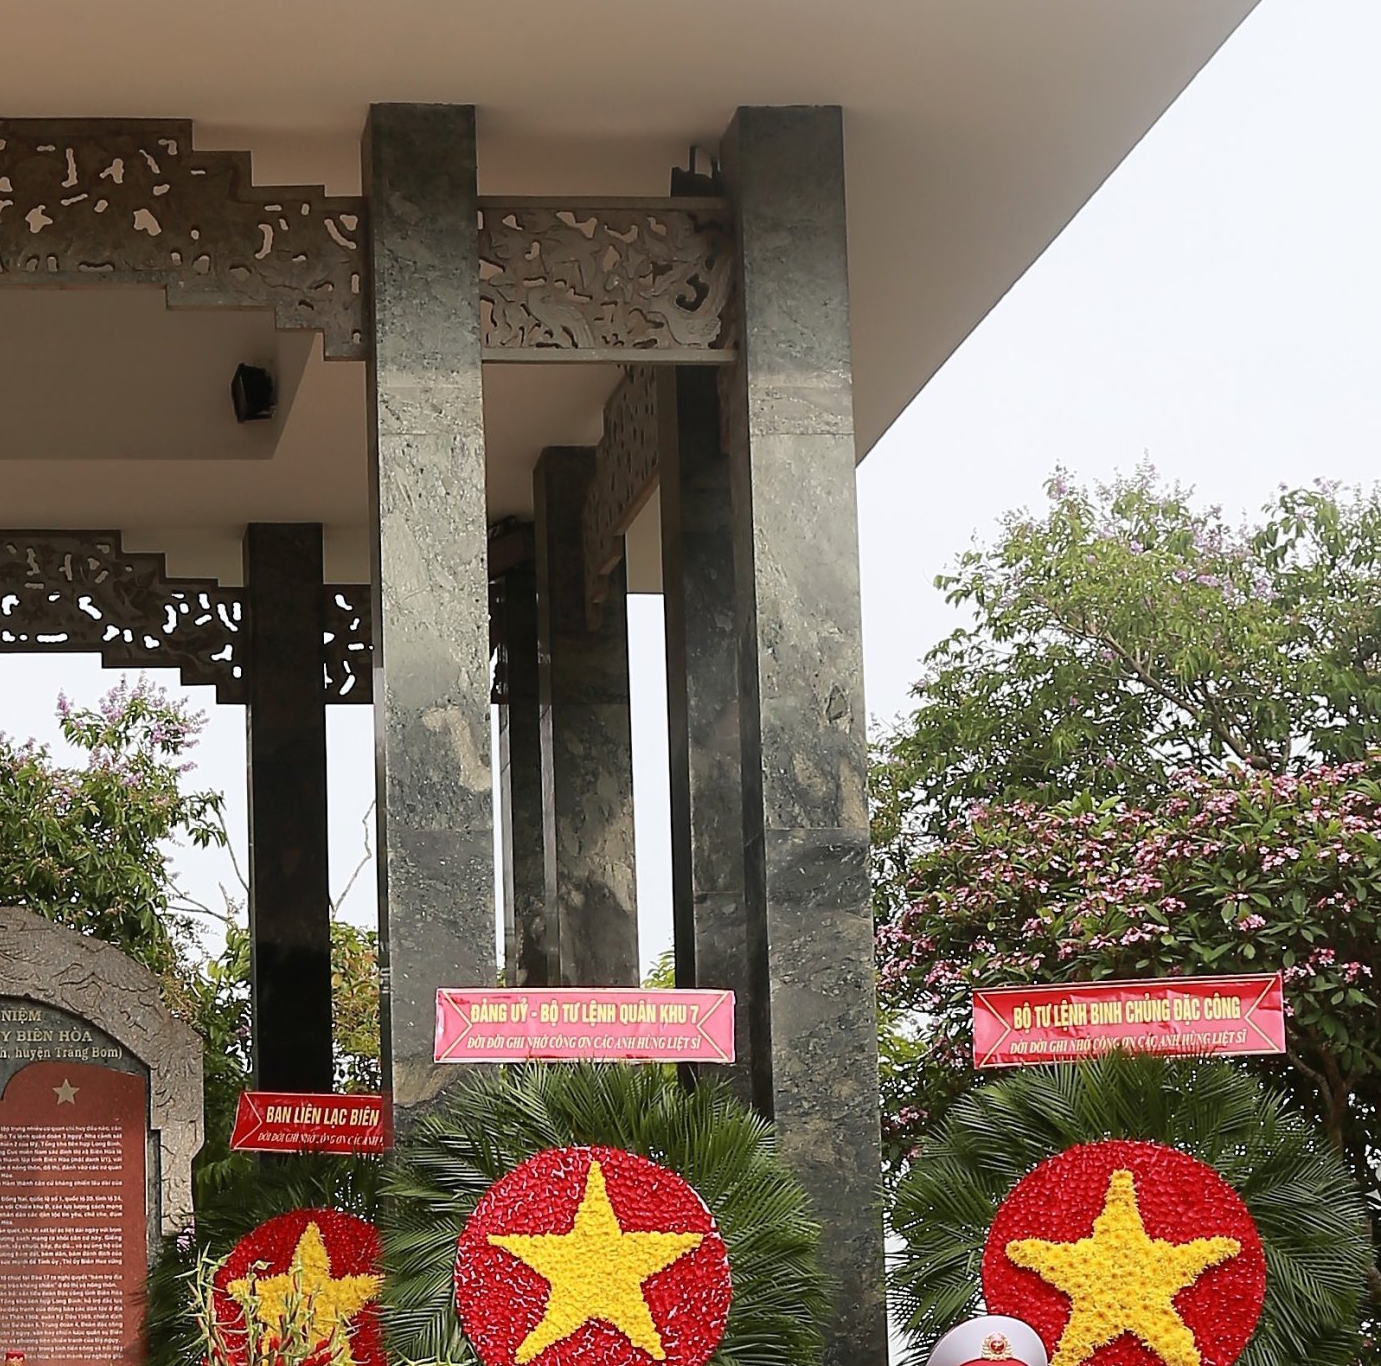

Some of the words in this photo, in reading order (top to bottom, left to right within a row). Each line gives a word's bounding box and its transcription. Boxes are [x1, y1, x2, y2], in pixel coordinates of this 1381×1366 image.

[1, 1008, 42, 1024] NIỆM
[470, 999, 507, 1024] ĐẢNG
[510, 998, 528, 1023] UỶ
[540, 1004, 558, 1027] BỘ
[562, 1003, 581, 1023] TƯ
[582, 1001, 616, 1027] LỆNH
[620, 1000, 656, 1025] QUÂN
[660, 1005, 687, 1024] KHU
[689, 1005, 700, 1024] 7
[1013, 1003, 1032, 1033] BỘ
[1034, 1004, 1054, 1028] TƯ
[1054, 999, 1087, 1031] LỆNH
[1090, 1001, 1123, 1025] BINH
[1126, 993, 1170, 1023] CHỦNG
[1173, 996, 1201, 1025] ĐẶC
[1204, 992, 1241, 1020] CÔNG
[16, 1028, 53, 1042] BIÊN
[59, 1026, 93, 1042] HÒA
[467, 1035, 486, 1049] ĐỜI
[487, 1035, 506, 1049] ĐỜI
[506, 1038, 525, 1049] GHI
[526, 1035, 549, 1050] NHỚ
[549, 1035, 577, 1050] CÔNG
[594, 1035, 616, 1050] CÁC
[616, 1038, 637, 1050] ANH
[637, 1035, 666, 1050] HÙNG
[667, 1037, 691, 1053] LIỆT
[1010, 1039, 1029, 1054] ĐỜI
[1029, 1038, 1048, 1053] ĐỜI
[1049, 1040, 1069, 1053] GHI
[1093, 1033, 1121, 1050] CÔNG
[1137, 1033, 1159, 1048] CÁC
[1160, 1035, 1181, 1047] ANH
[1182, 1031, 1211, 1047] HÙNG
[1211, 1030, 1237, 1047] LIỆT
[15, 1046, 51, 1061] huyện
[54, 1046, 89, 1061] Trảng
[266, 1106, 291, 1124] BAN
[294, 1103, 321, 1125] LIÊN
[324, 1108, 348, 1129] LẠC
[350, 1106, 380, 1126] BIÊN
